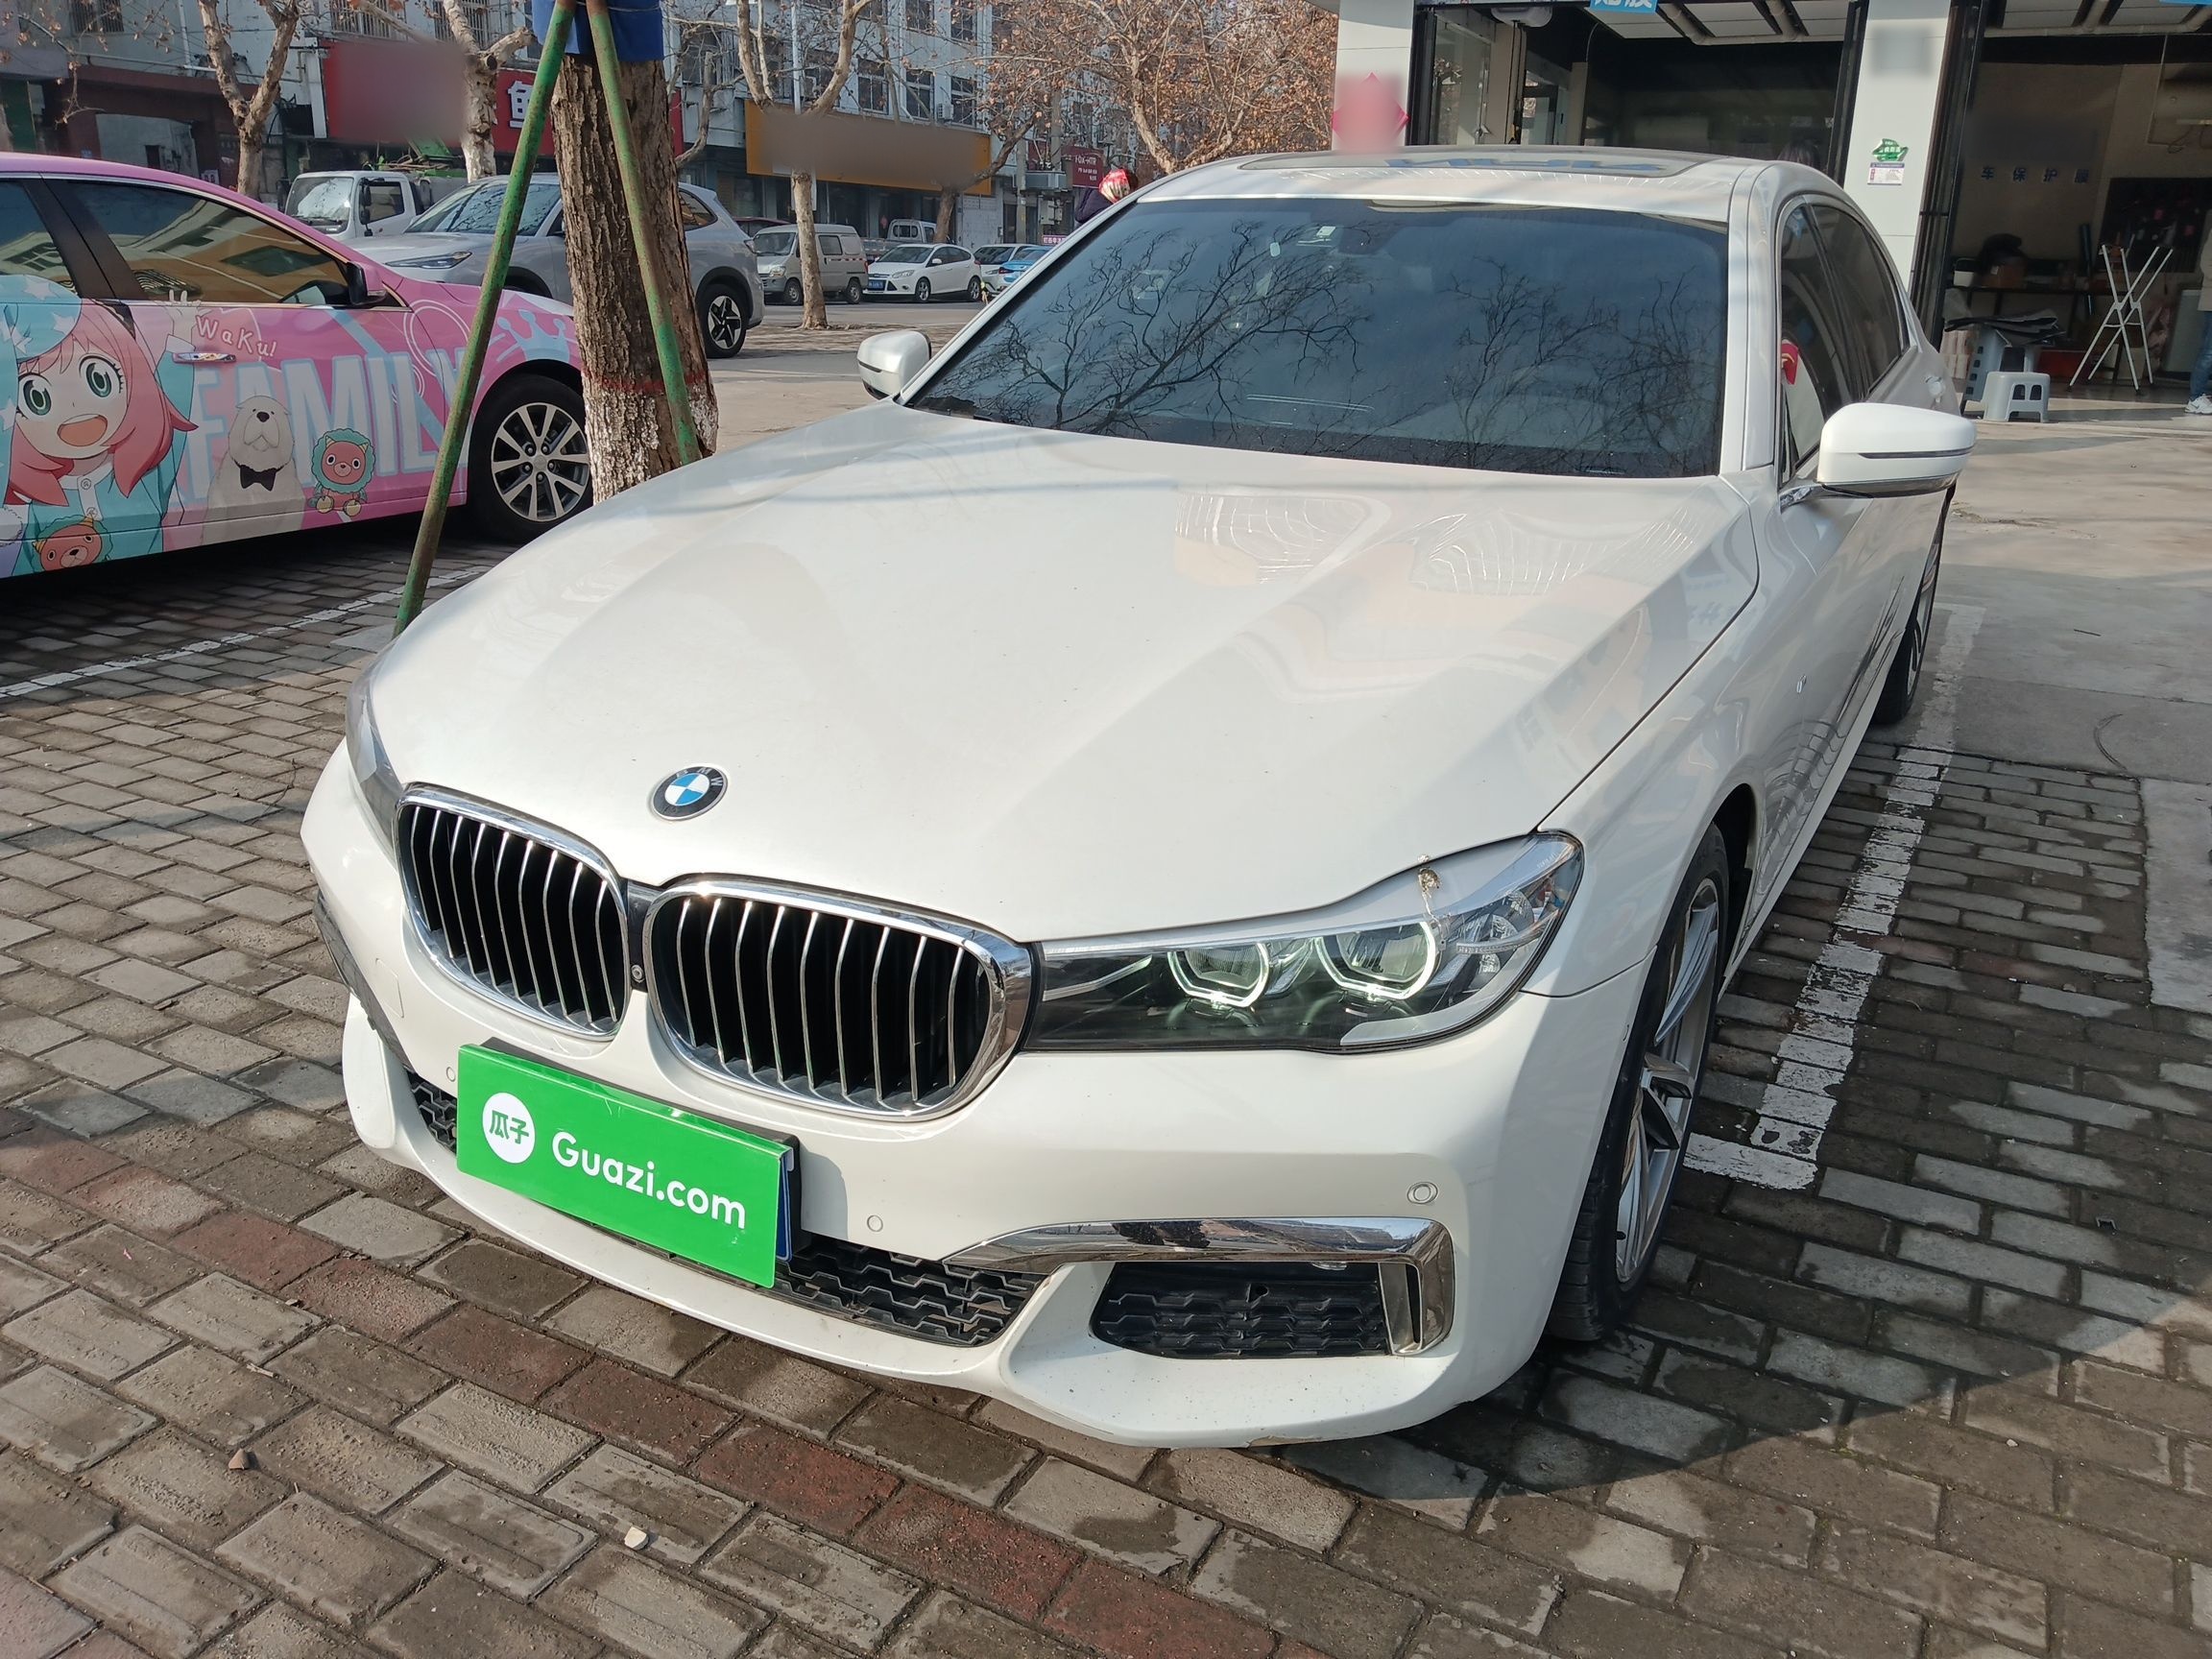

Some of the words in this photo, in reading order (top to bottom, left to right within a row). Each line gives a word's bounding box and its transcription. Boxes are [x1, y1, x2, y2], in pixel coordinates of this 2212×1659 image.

[675, 766, 725, 787] BMW
[489, 1109, 530, 1145] 瓜子
[551, 1130, 746, 1230] Guazi.com
